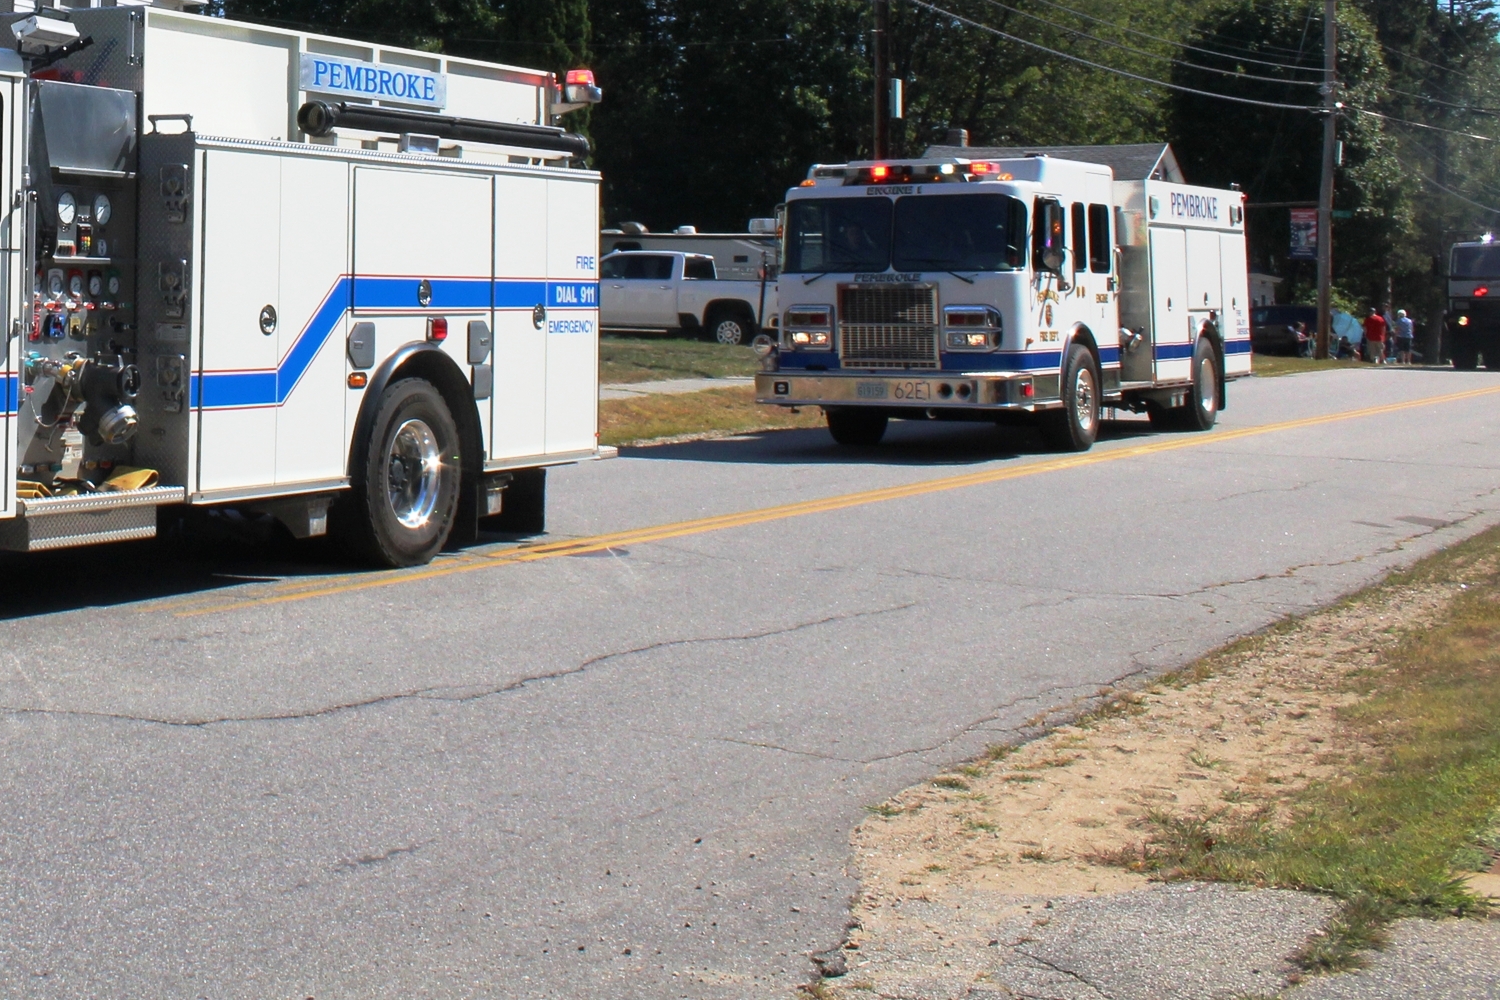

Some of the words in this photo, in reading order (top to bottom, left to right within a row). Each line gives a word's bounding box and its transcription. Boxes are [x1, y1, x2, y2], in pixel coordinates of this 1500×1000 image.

[313, 60, 436, 101] PEMBROKE
[866, 185, 914, 196] ENGINE
[1170, 192, 1218, 219] PEMBROKE
[575, 255, 595, 270] FIRE
[555, 285, 578, 303] DIAL
[580, 286, 595, 304] 911
[548, 320, 594, 334] EMERGENCY
[894, 381, 932, 400] 62E1
